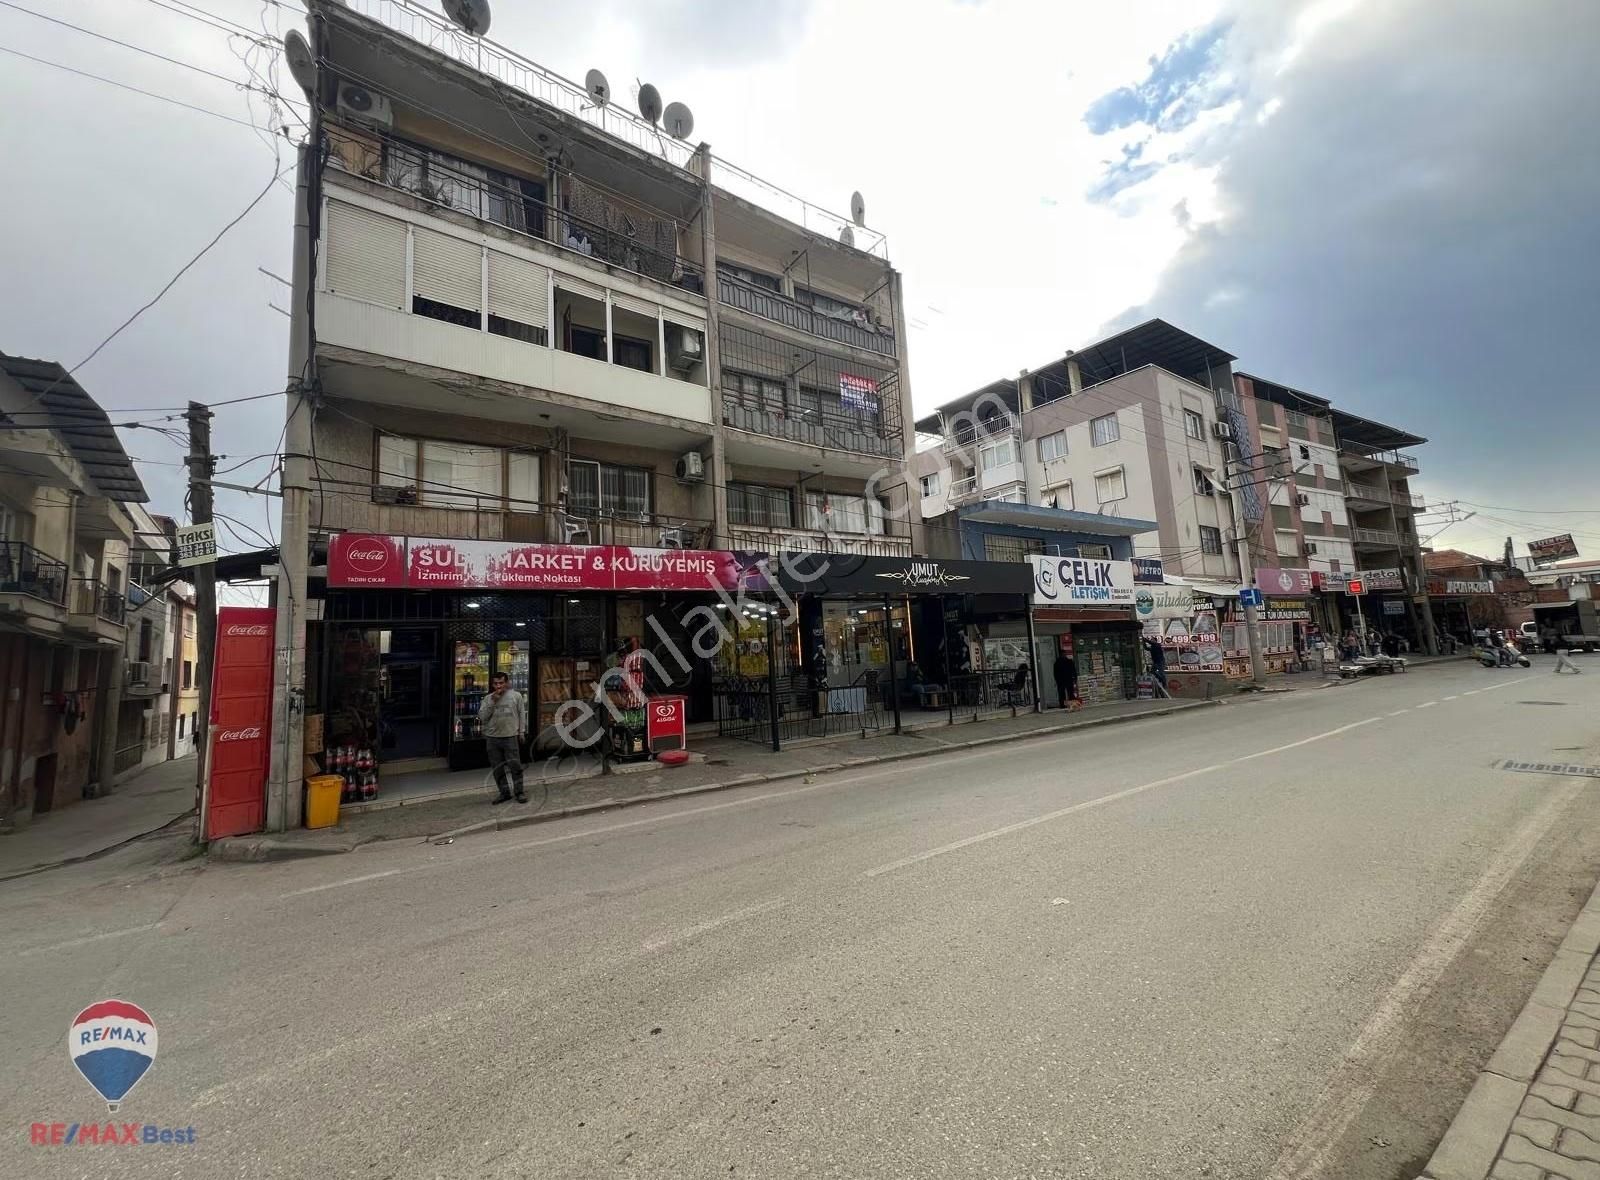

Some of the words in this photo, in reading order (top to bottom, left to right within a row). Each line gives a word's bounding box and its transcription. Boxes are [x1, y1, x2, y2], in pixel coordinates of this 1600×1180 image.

[418, 548, 479, 567] SUD
[492, 553, 587, 570] MARKET
[592, 556, 605, 571] &
[912, 562, 939, 576] UMUT
